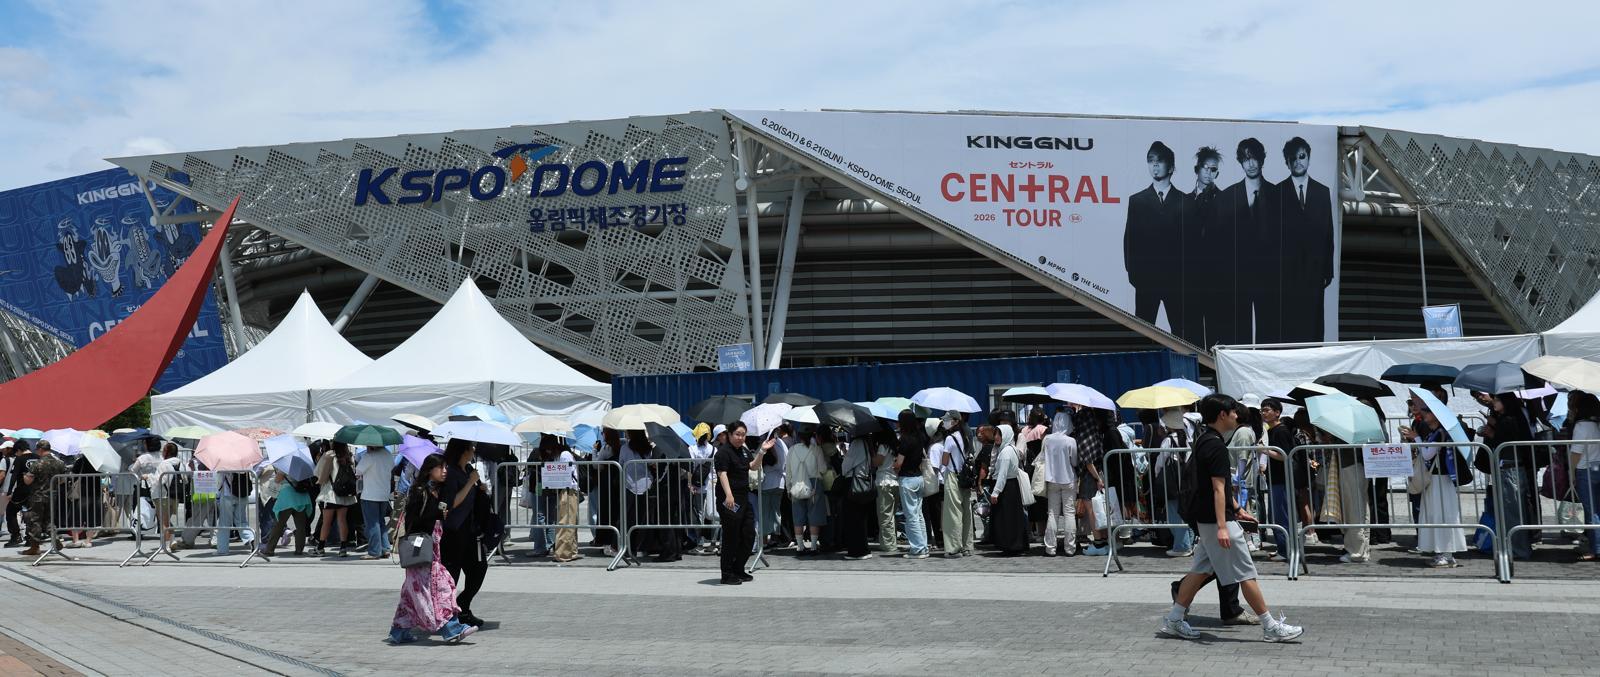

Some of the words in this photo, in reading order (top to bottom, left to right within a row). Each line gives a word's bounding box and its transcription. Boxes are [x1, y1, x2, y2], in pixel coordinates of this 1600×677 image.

[966, 135, 1094, 151] KINGGNU
[761, 117, 800, 143] 6.20(SAT)
[799, 137, 806, 145] &
[806, 140, 844, 165] 6.21(SUN)
[847, 161, 870, 179] KSPO
[869, 173, 895, 193] DOME,
[896, 185, 922, 205] SEOUL
[1008, 161, 1054, 169] セントラル
[354, 165, 506, 206] KSPO
[529, 156, 689, 198] DOME
[526, 203, 688, 233] 올림픽체조경기장
[974, 213, 996, 221] 2026
[1002, 208, 1062, 227] TOUR
[1047, 261, 1066, 273] MPMG
[1080, 277, 1091, 286] THE
[1093, 282, 1110, 295] VAULT
[1387, 446, 1403, 454] 주의
